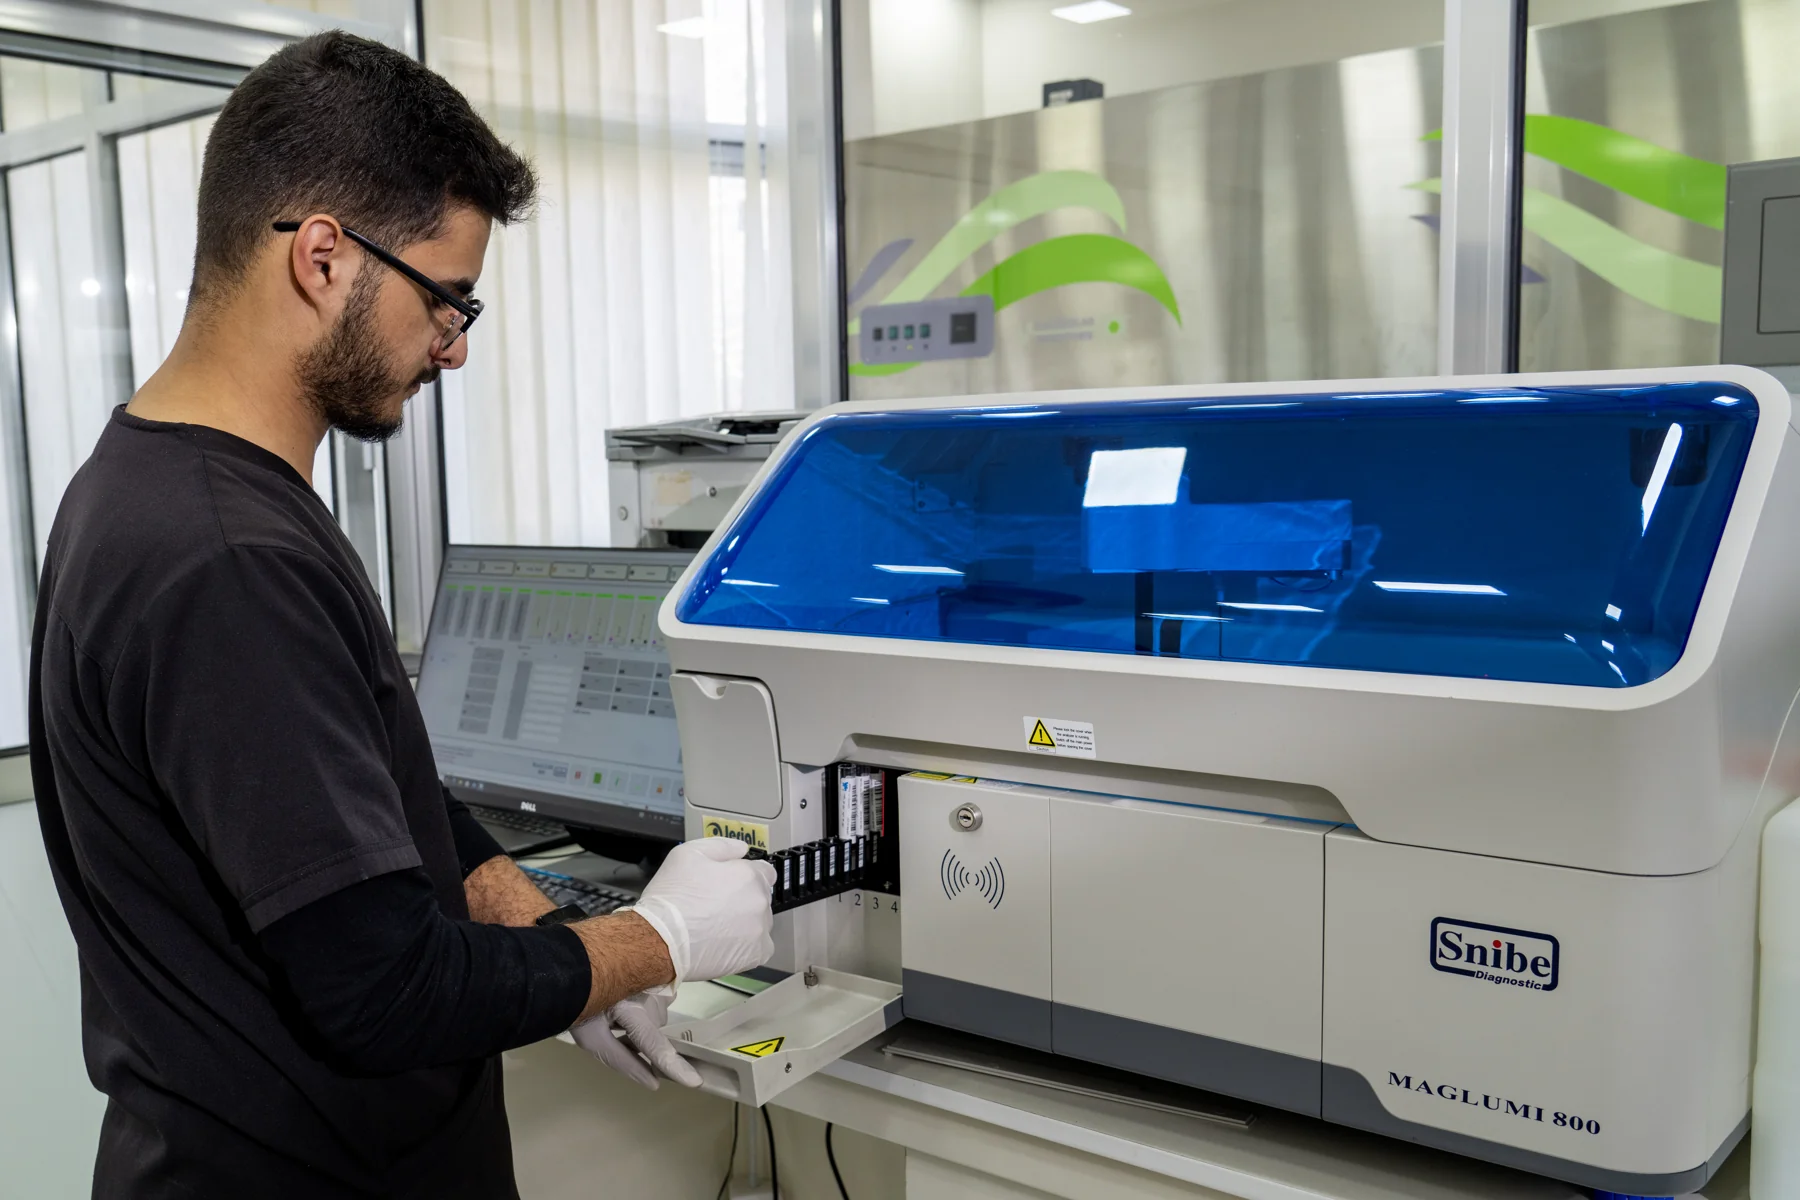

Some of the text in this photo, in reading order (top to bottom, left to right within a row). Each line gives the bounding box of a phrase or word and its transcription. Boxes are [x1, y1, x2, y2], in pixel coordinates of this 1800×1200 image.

[520, 801, 536, 812] DELL
[854, 894, 861, 906] 2
[873, 897, 879, 909] 3
[891, 901, 898, 913] 4
[1438, 930, 1551, 977] Snibe
[1475, 970, 1544, 990] Diagnostic
[1388, 1071, 1600, 1135] MAGLUMI 800
